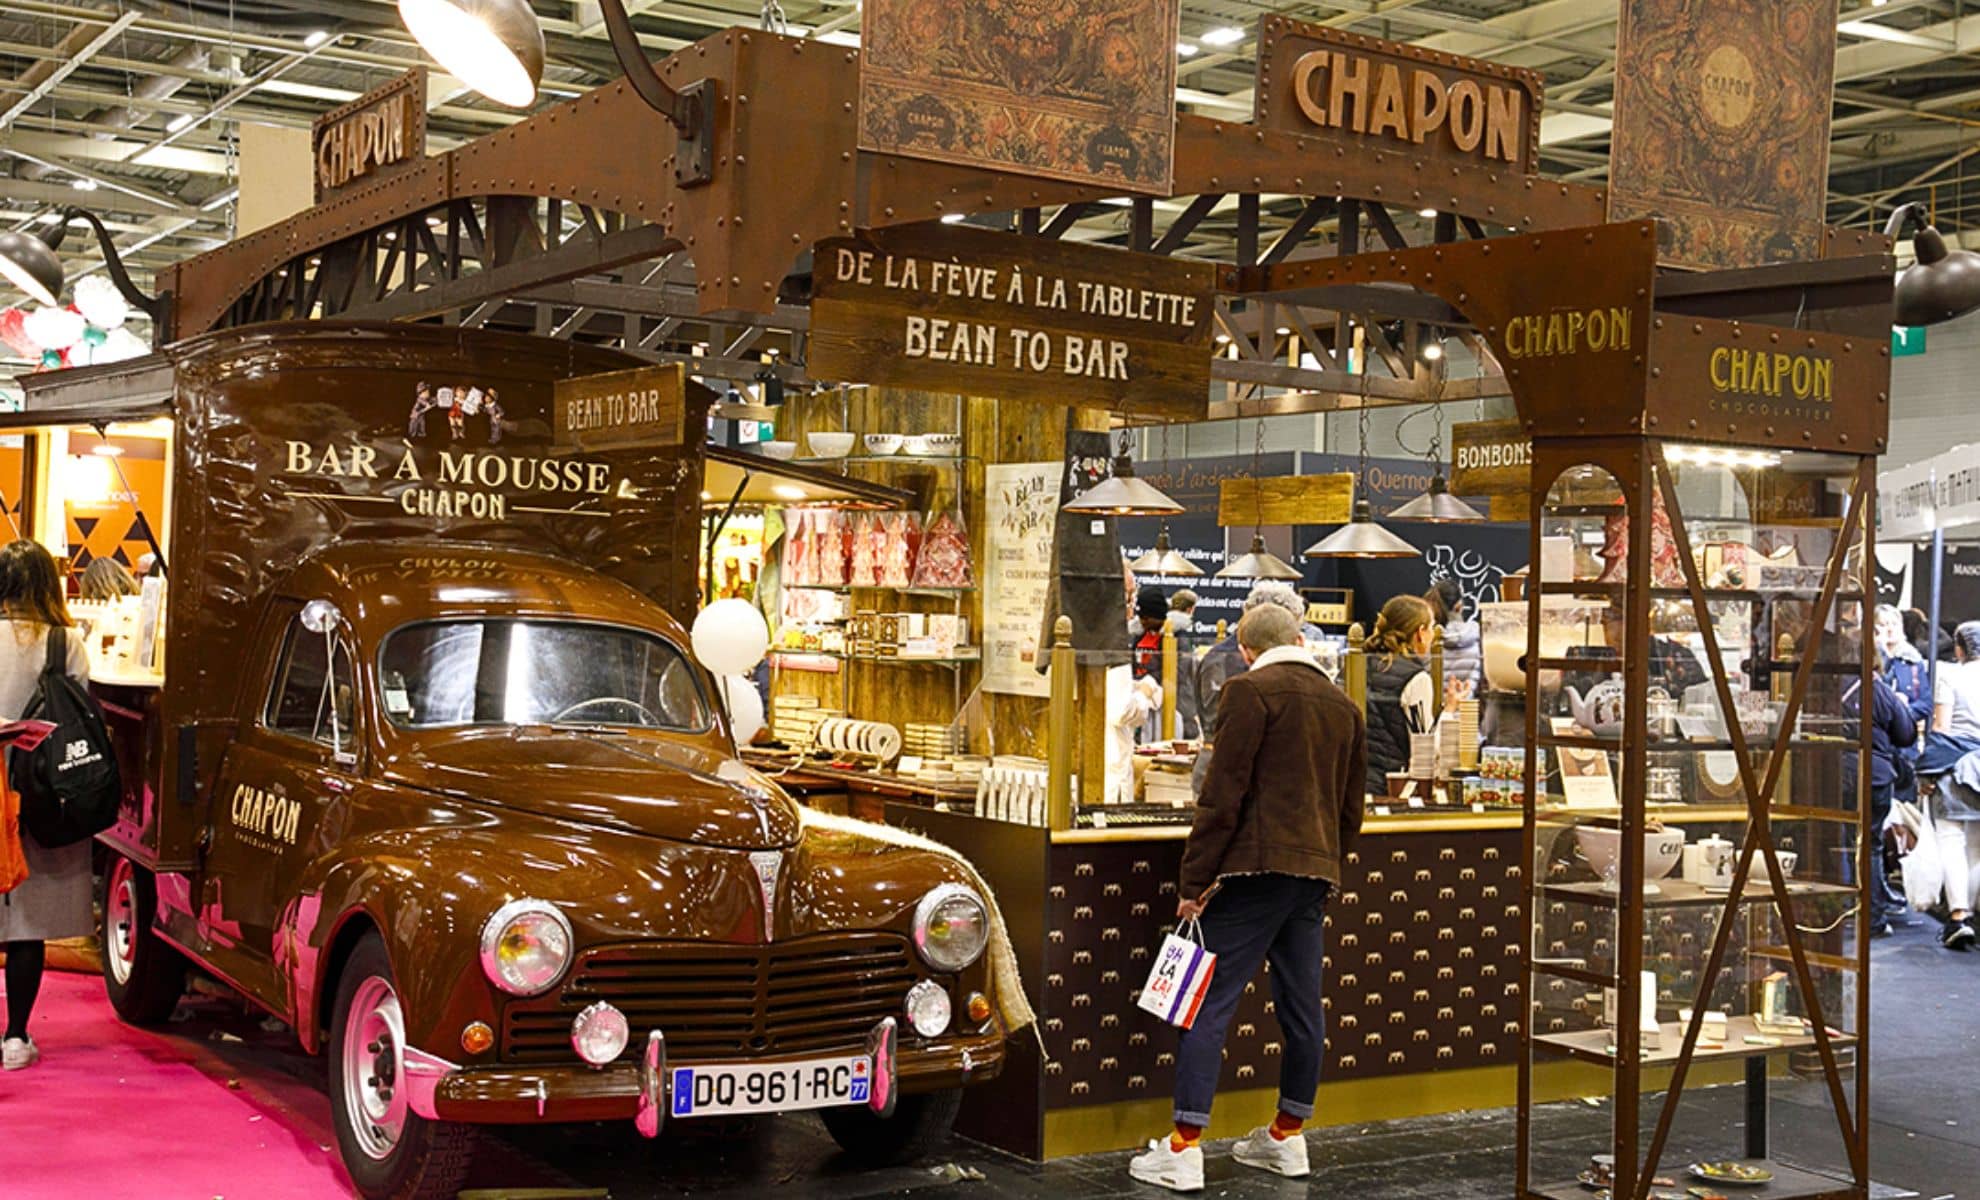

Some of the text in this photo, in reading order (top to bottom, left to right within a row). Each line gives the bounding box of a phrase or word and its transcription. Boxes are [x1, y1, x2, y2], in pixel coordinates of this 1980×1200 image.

[1293, 50, 1521, 162] CHAPON
[320, 92, 406, 188] CHAPON
[836, 249, 1196, 327] DE LA FÈVE À LA TABLETTE
[905, 316, 1129, 380] BEAN TO BAR
[1505, 307, 1633, 359] CHAPON
[1710, 346, 1834, 402] CHAPON
[567, 389, 660, 431] BEAN TO BAR
[1709, 399, 1832, 421] CHOCOLATIER
[285, 437, 611, 494] BAR À MOUSSE
[400, 487, 506, 520] CHAPON
[232, 784, 301, 845] CHAPON
[679, 1065, 866, 1107] F DQ-961-RC 77
